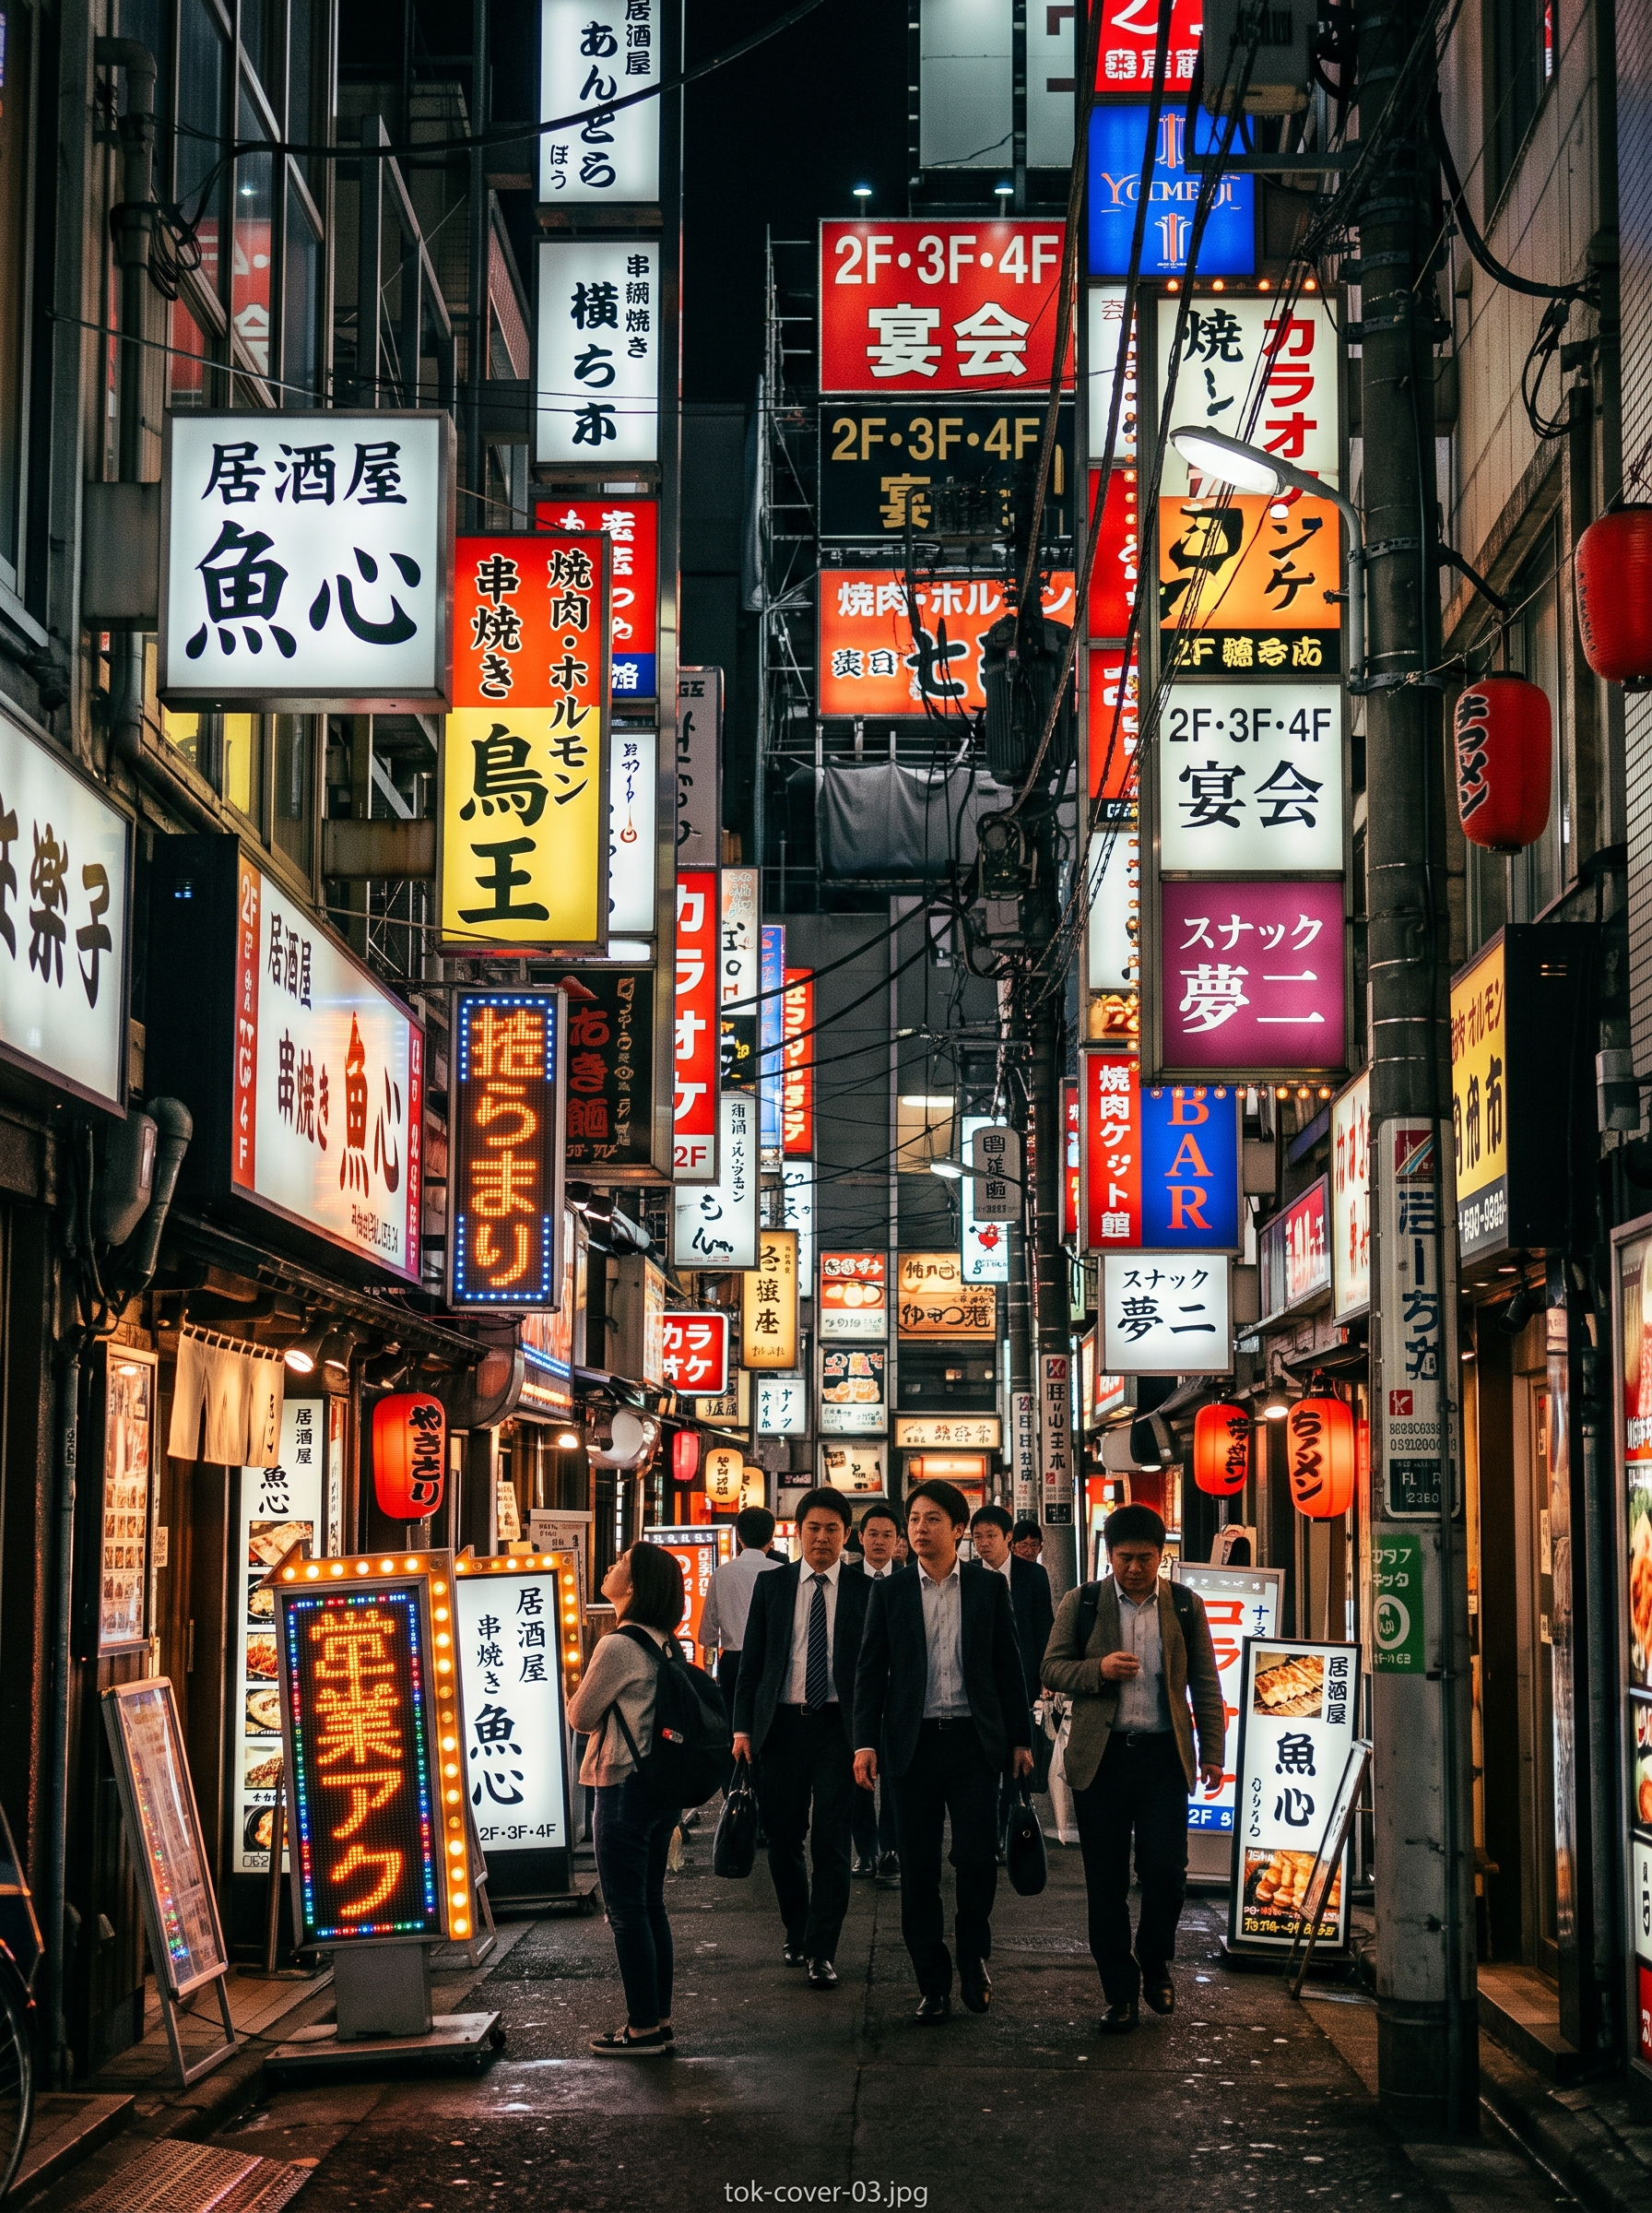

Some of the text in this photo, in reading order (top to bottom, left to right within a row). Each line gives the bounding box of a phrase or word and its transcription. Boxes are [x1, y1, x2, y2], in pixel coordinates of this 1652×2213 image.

[625, 0, 652, 75] 居酒屋
[866, 302, 1032, 378] 宴会
[200, 441, 407, 506] 居酒屋
[185, 520, 422, 660] 魚心
[470, 554, 524, 700] 串焼き
[547, 549, 594, 808] 焼肉・ホルモン
[456, 723, 551, 925] 鳥王
[1178, 760, 1325, 829] 宴会
[267, 911, 313, 1011] 居酒屋
[1179, 914, 1324, 952] スナック
[675, 884, 707, 1122] カラオケ
[1179, 964, 1326, 1034] 夢二
[277, 1027, 330, 1153] 串焼き
[339, 1011, 403, 1199] 魚心
[1117, 1296, 1217, 1343] 夢二
[1122, 1268, 1210, 1291] スナック
[295, 1408, 313, 1464] 居酒屋
[259, 1464, 290, 1515] 魚心
[476, 1613, 503, 1696] 串焼き
[516, 1586, 549, 1685] 居酒屋
[1326, 1655, 1350, 1726] 居酒屋
[469, 1703, 525, 1808] 魚心
[1274, 1731, 1316, 1828] 魚心
